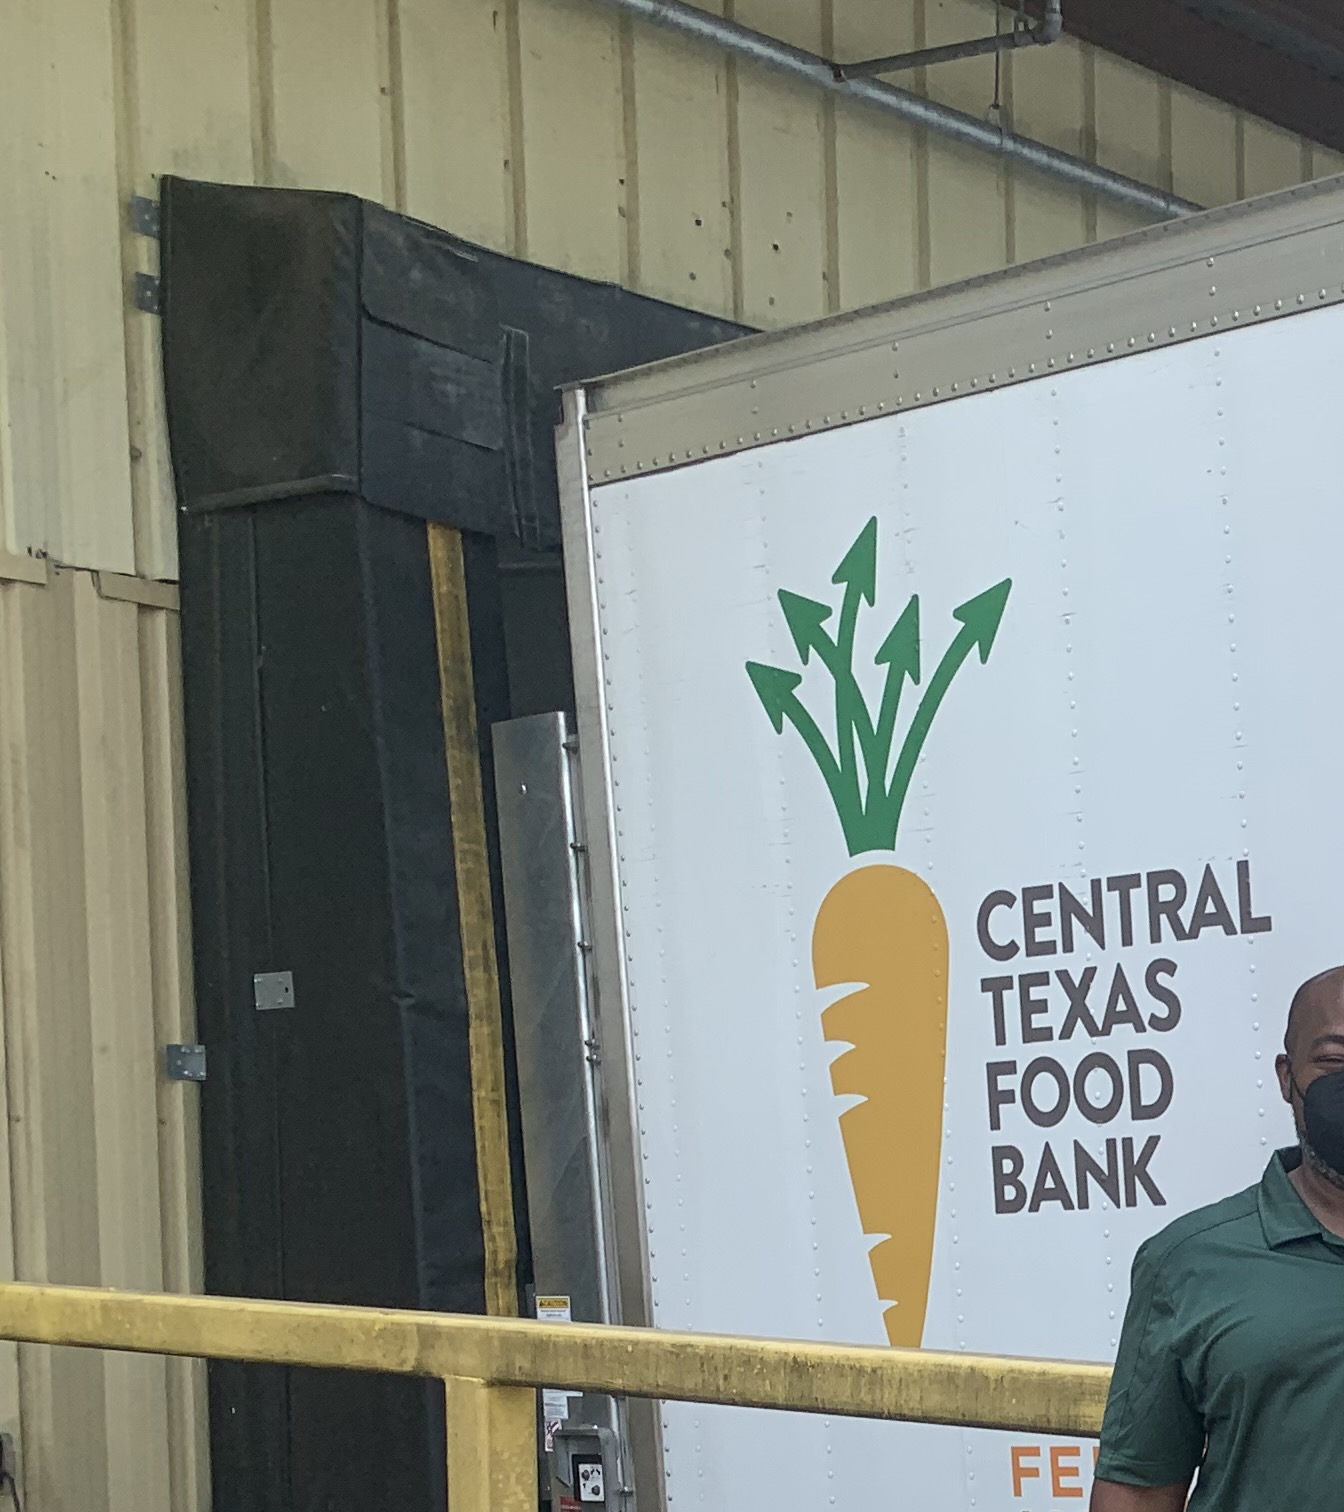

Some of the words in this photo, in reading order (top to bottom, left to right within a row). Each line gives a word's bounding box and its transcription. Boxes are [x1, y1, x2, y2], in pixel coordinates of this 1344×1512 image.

[976, 860, 1272, 962] CENTRAL
[981, 959, 1182, 1046] TEXAS
[986, 1049, 1174, 1131] FOOD
[991, 1135, 1168, 1214] BANK
[1010, 1446, 1099, 1497] FE
